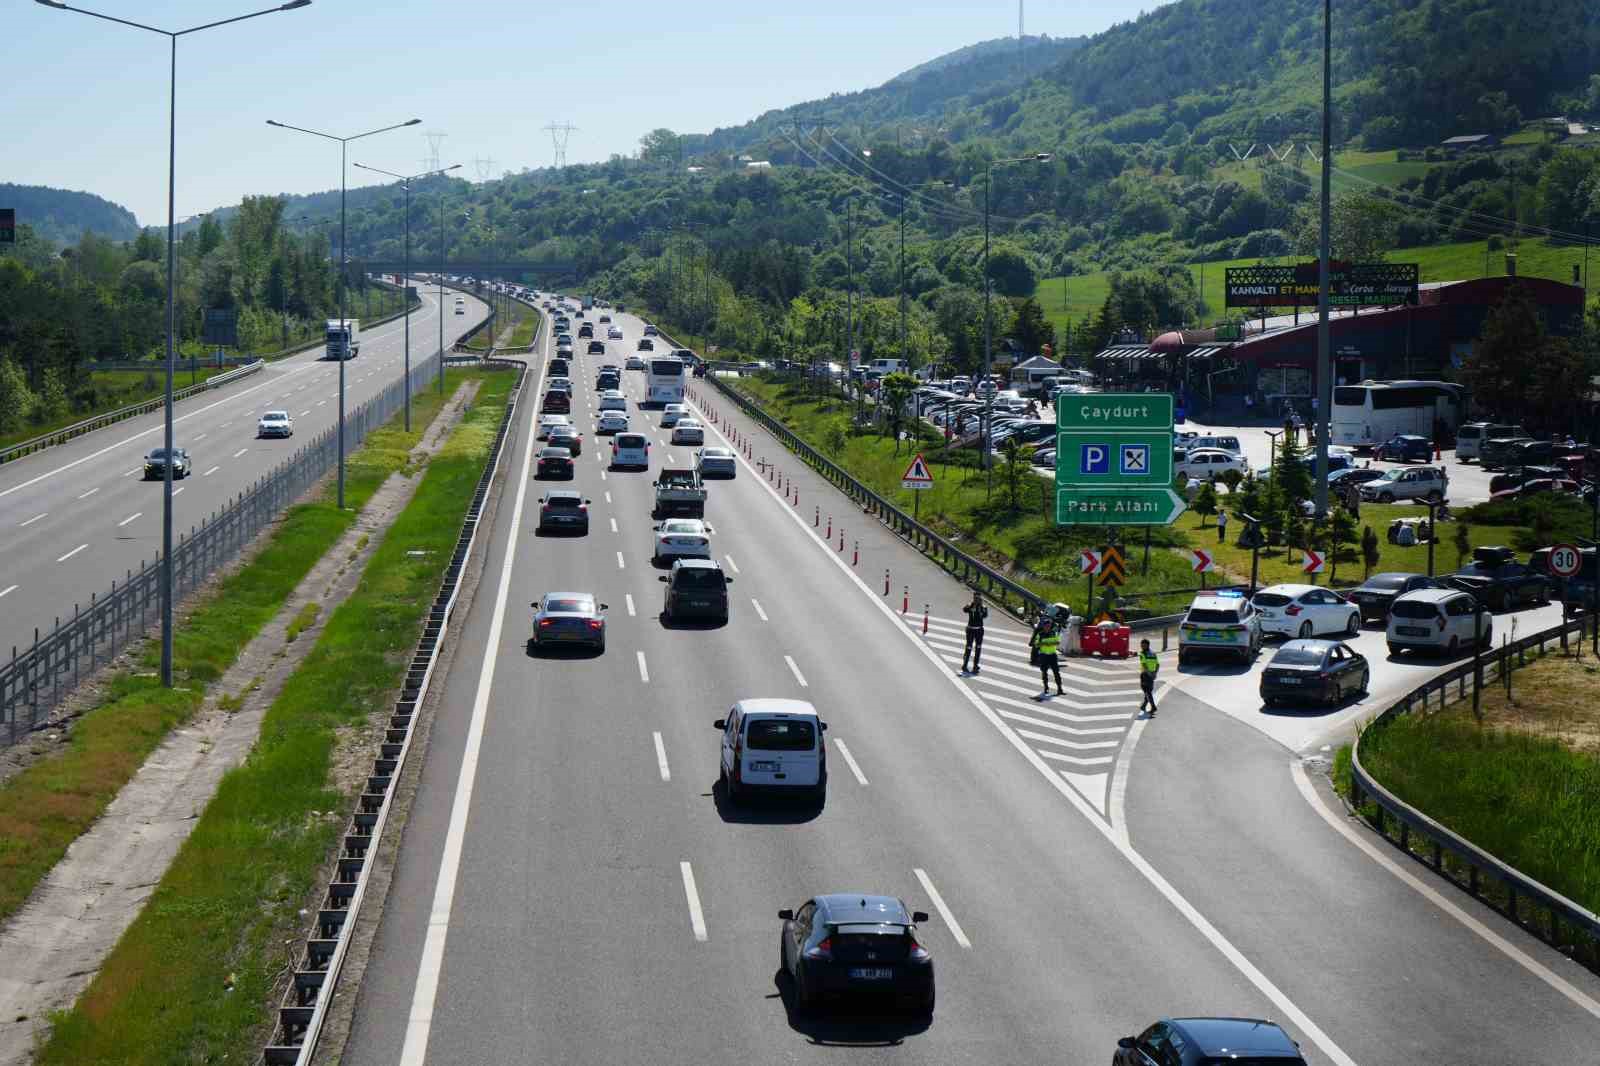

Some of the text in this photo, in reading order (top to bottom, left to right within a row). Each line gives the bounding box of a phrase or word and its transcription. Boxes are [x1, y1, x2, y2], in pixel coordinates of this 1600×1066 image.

[1231, 286, 1277, 295] KAHVALTI
[1281, 286, 1292, 295] ET
[1080, 405, 1148, 420] Çaydurt
[1086, 446, 1104, 472] P
[1067, 500, 1159, 512] Park Alanı
[1555, 551, 1574, 568] 30
